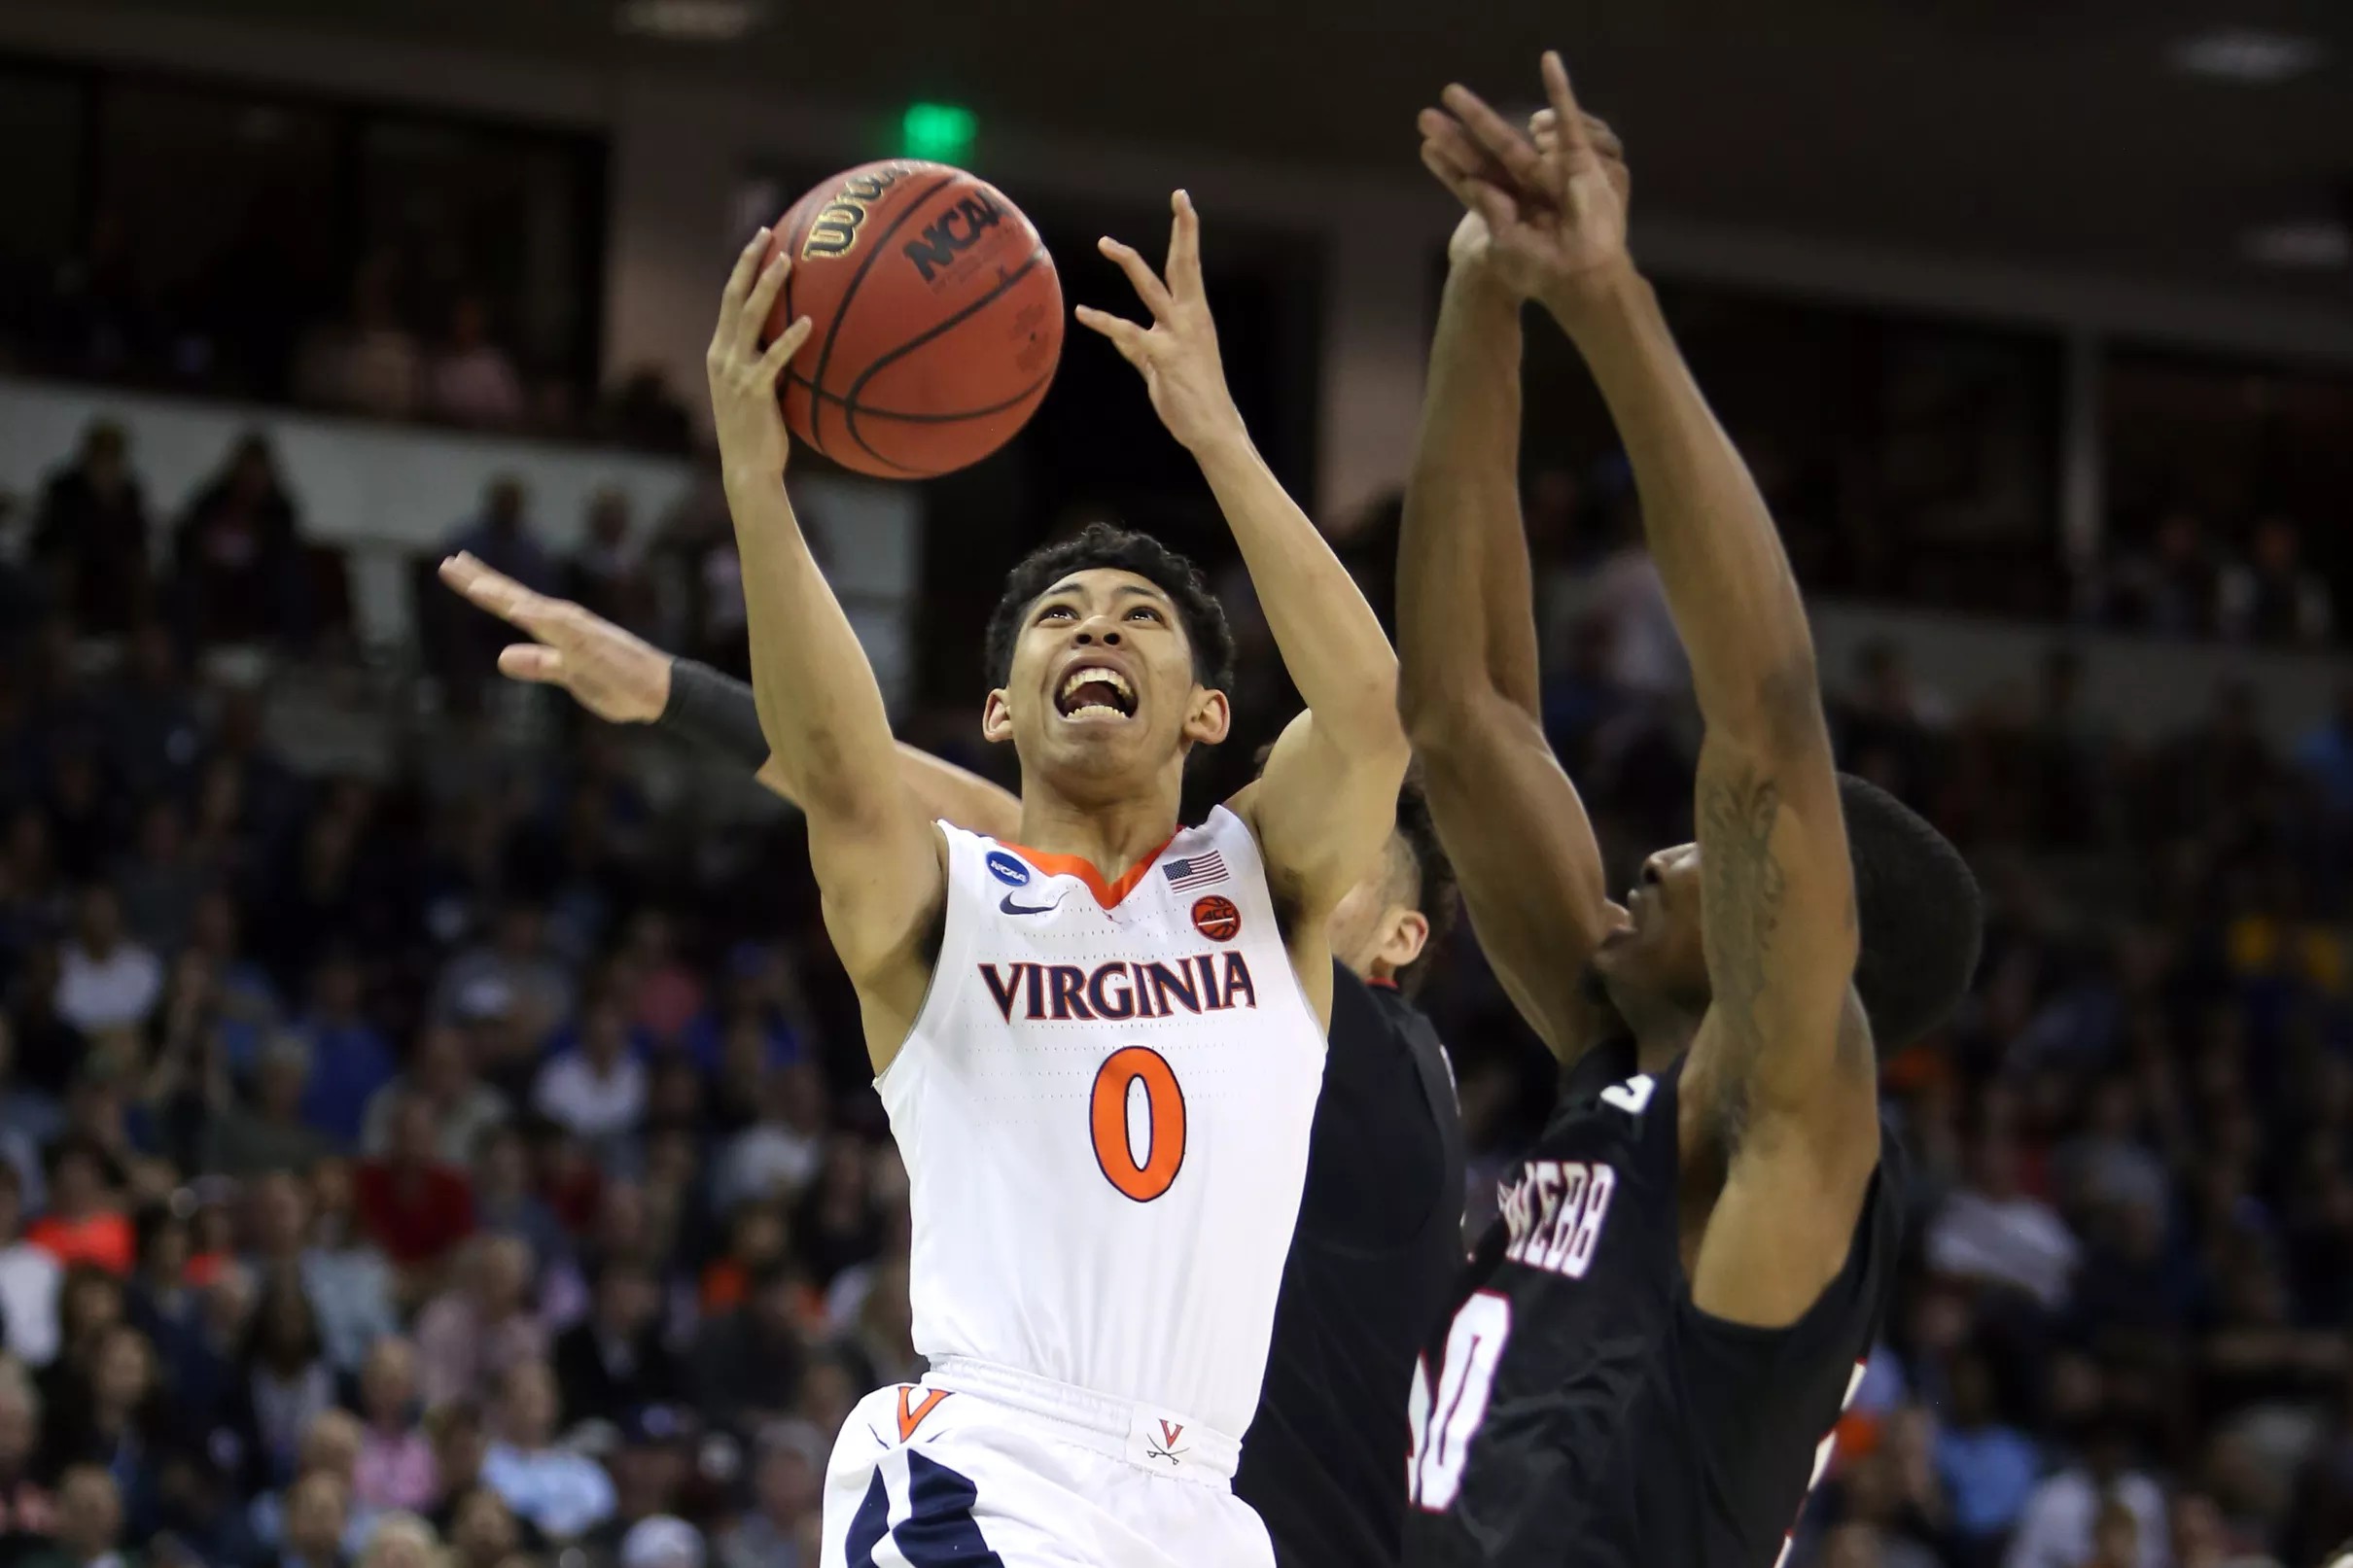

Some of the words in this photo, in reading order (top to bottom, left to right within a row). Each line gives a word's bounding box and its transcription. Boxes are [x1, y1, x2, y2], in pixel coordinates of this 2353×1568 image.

[990, 859, 1027, 884] NCAA
[976, 950, 1257, 1025] VIRGINIA
[1089, 1045, 1187, 1203] 0
